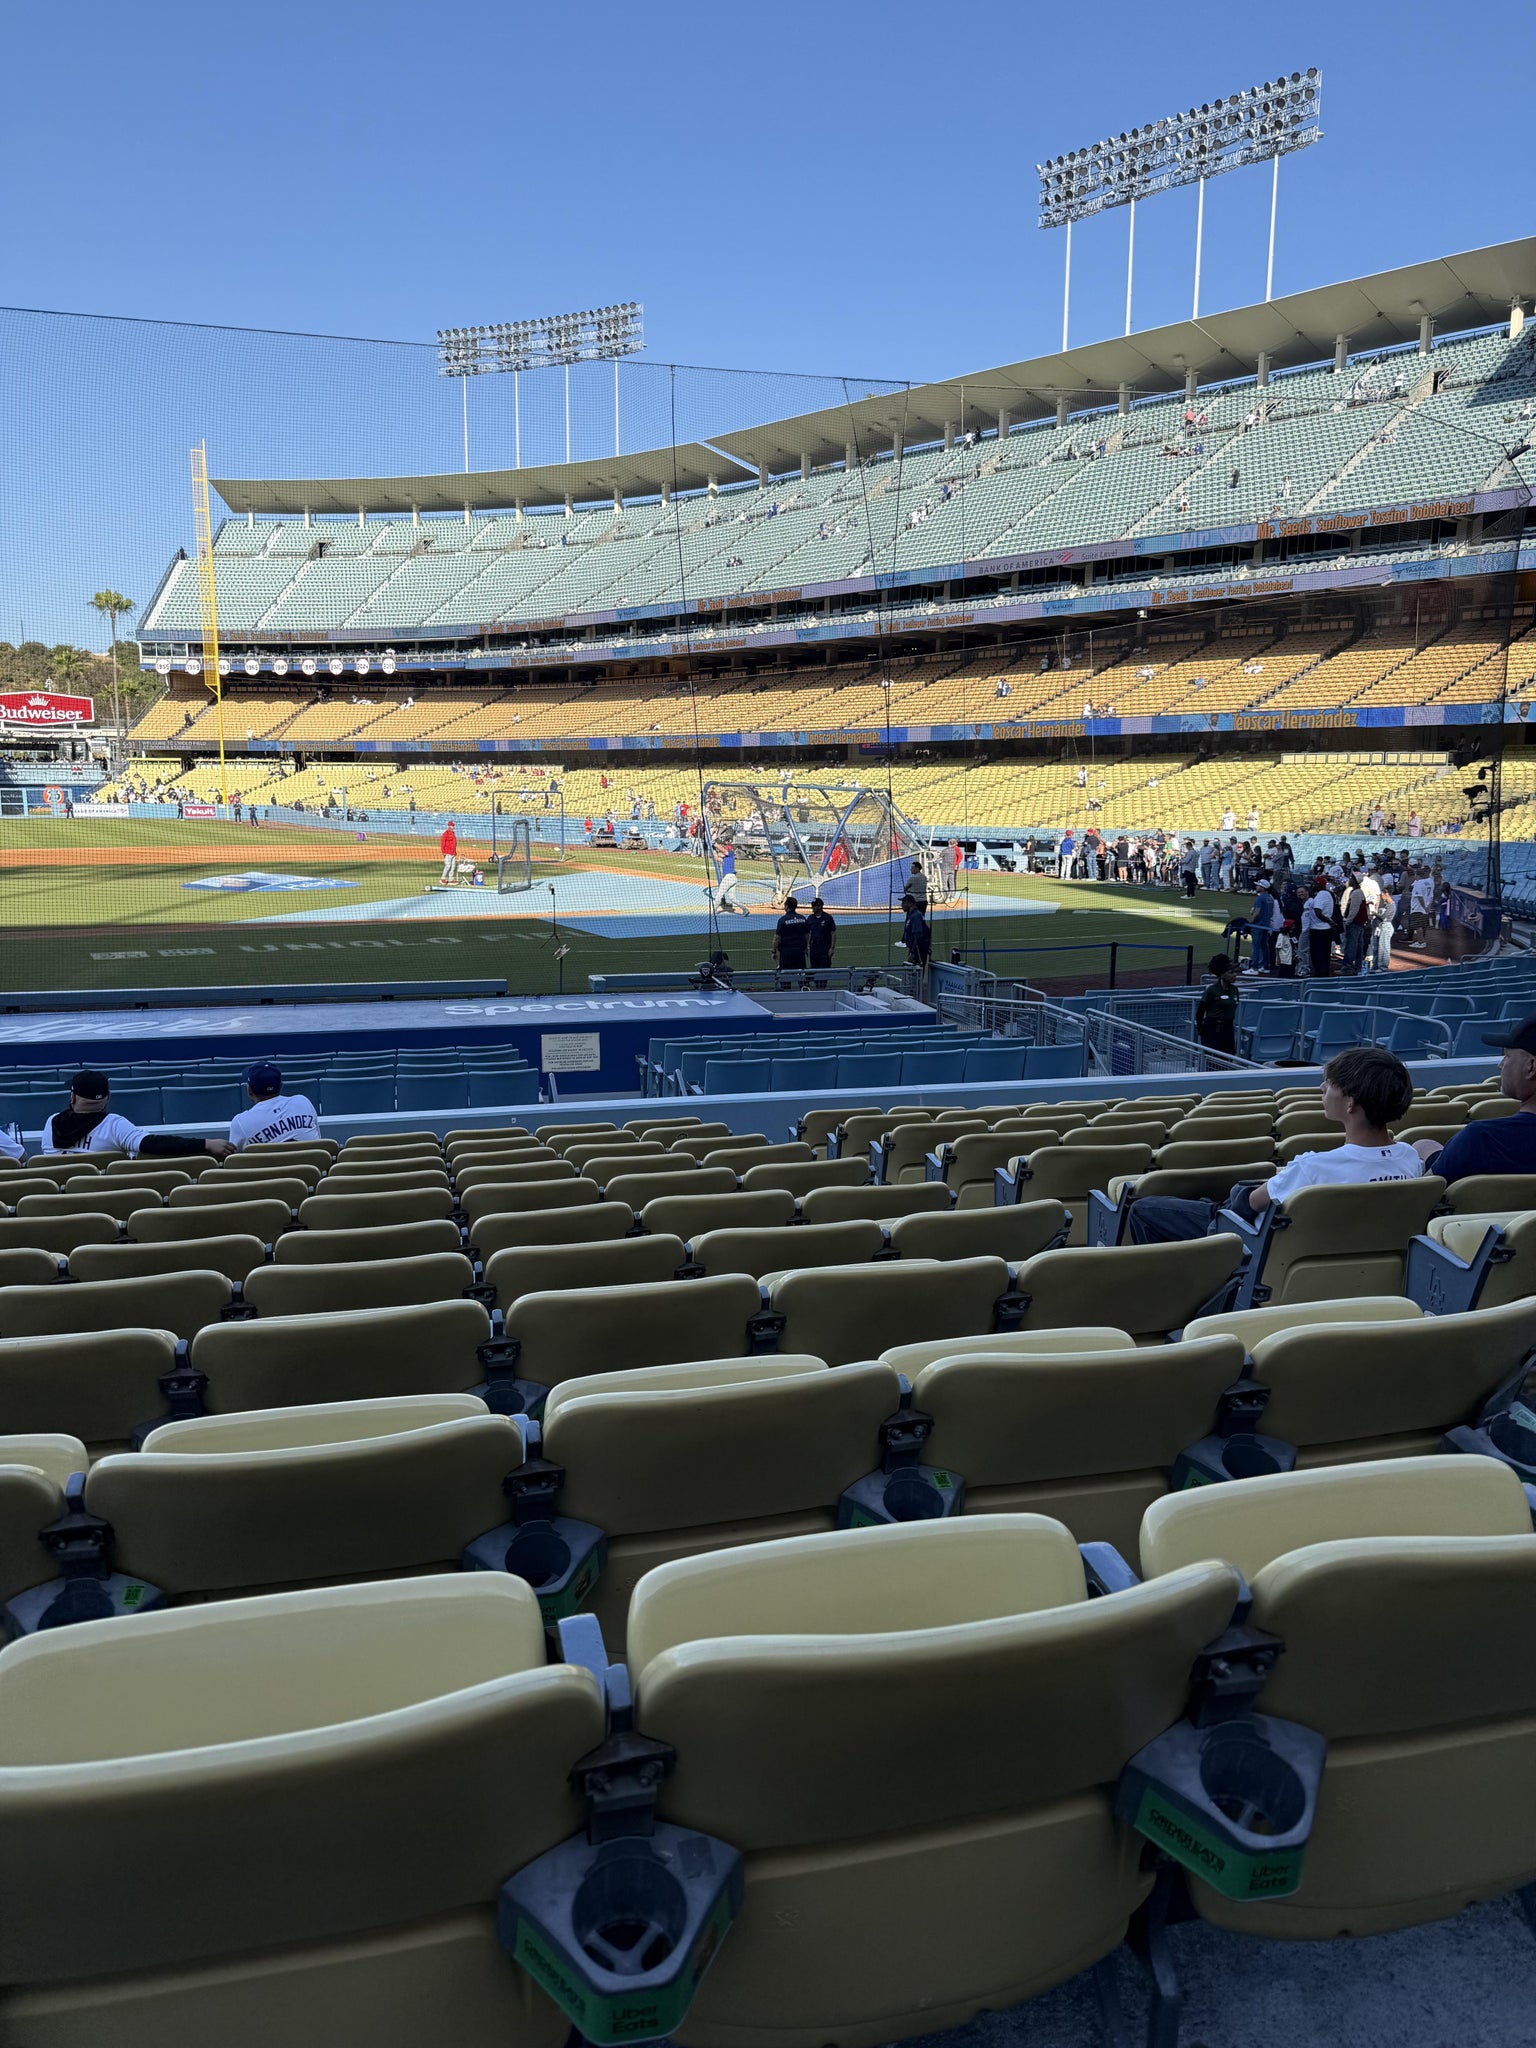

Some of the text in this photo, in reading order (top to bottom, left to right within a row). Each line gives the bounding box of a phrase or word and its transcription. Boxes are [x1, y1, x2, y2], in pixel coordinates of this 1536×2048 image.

[1257, 521, 1277, 540] Mr.
[1279, 518, 1311, 538] Seeds
[1316, 514, 1367, 532] Sunflower
[1369, 507, 1407, 526] Tossing
[1081, 549, 1118, 561] Suite Level
[979, 557, 1054, 574] BANK OF AMERICA
[1233, 709, 1358, 731] Teoscar Hernández
[992, 719, 1086, 739] Teoscar Hernández
[238, 930, 601, 953] UNIQLO FIEL
[445, 998, 711, 1016] Spectrum
[1252, 1863, 1290, 1879] Uber
[1249, 1876, 1288, 1891] Eats
[612, 2005, 659, 2021] Uber
[612, 2018, 660, 2034] Eats
